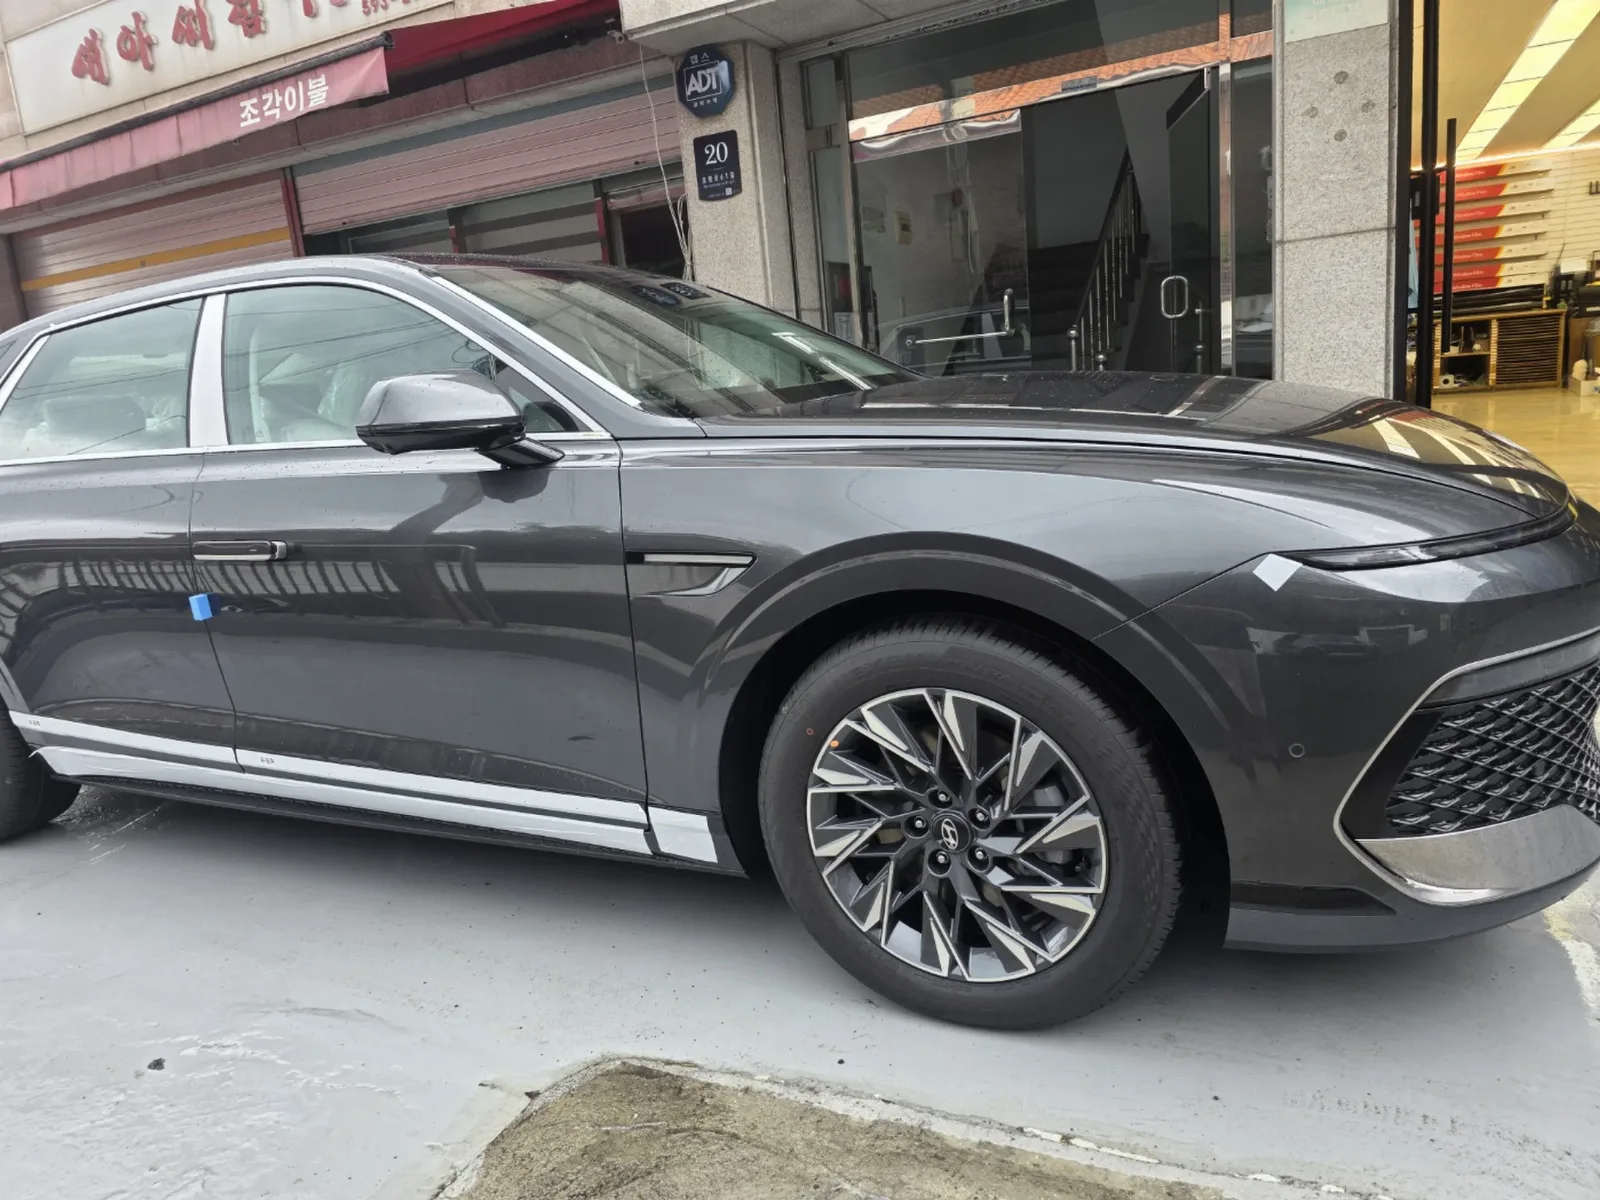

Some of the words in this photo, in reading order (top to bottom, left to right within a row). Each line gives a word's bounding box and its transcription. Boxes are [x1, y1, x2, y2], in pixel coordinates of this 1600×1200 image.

[686, 66, 720, 96] ADT
[239, 73, 329, 127] 조각이불
[705, 142, 728, 165] 20
